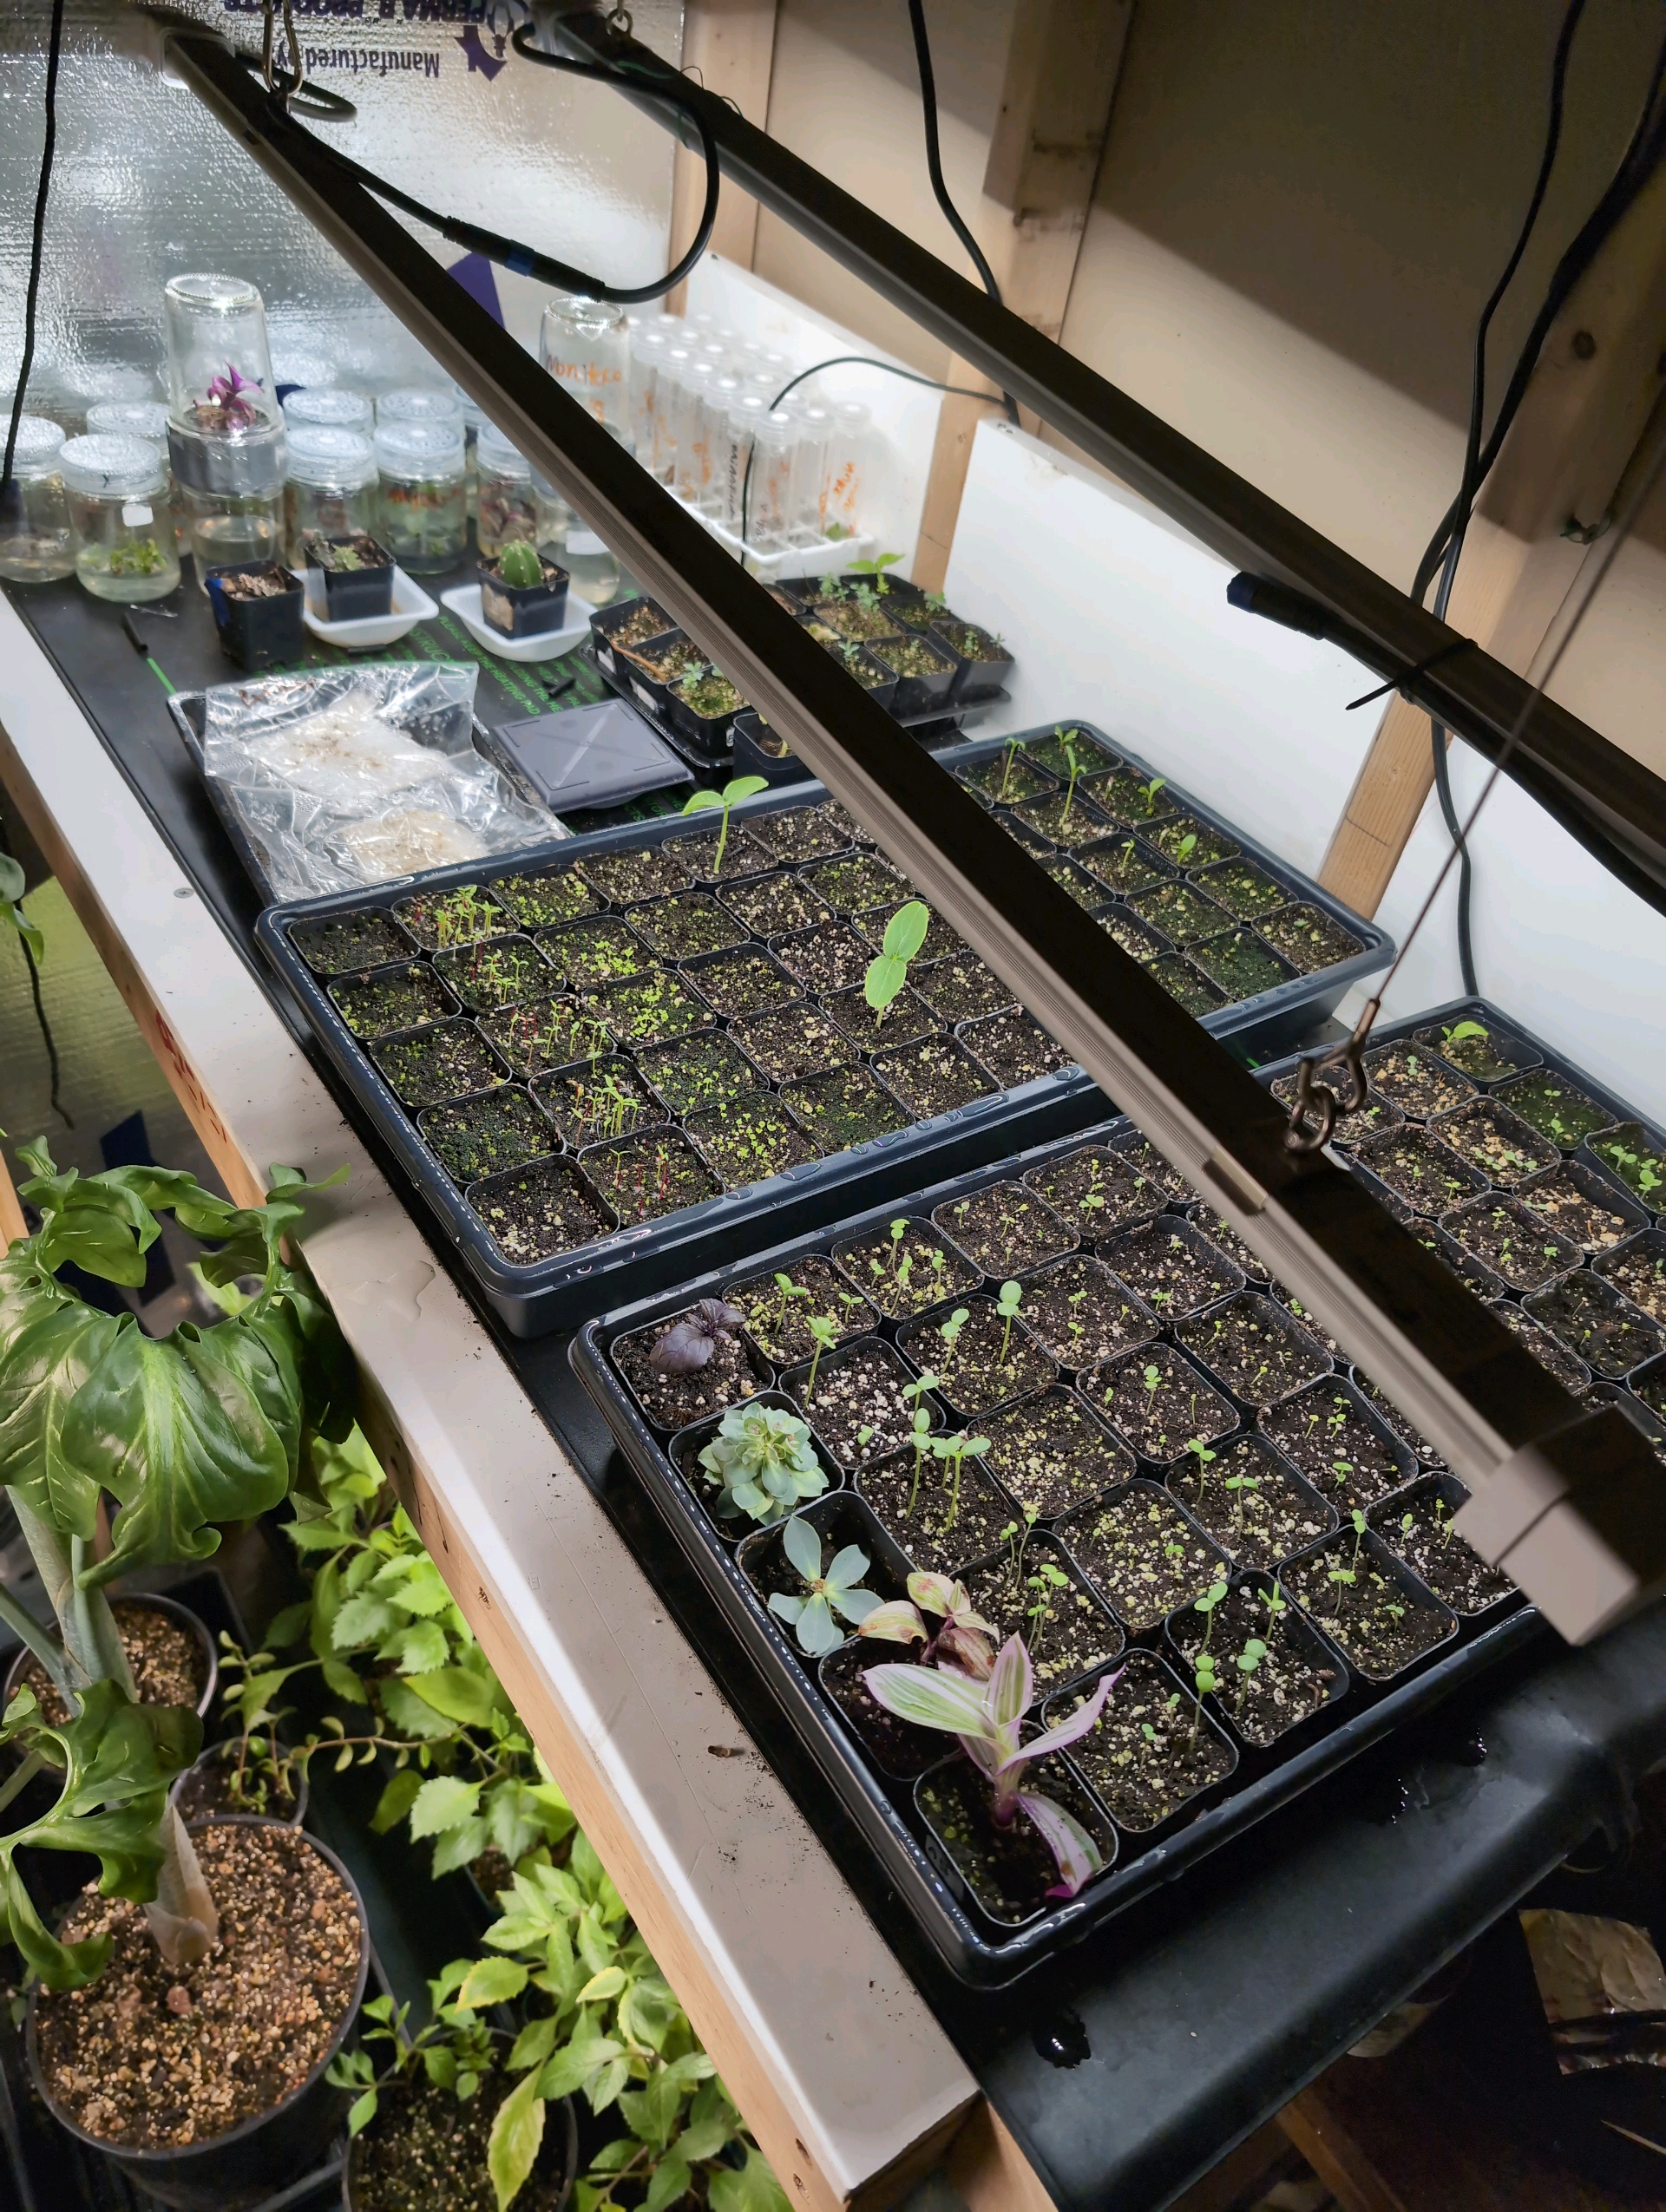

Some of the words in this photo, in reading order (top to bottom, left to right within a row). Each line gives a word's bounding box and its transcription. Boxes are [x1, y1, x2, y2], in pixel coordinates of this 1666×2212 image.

[305, 48, 440, 77] Manufactured
[478, 655, 497, 672] THE
[490, 666, 527, 703] HEATING
[521, 697, 541, 715] PAD
